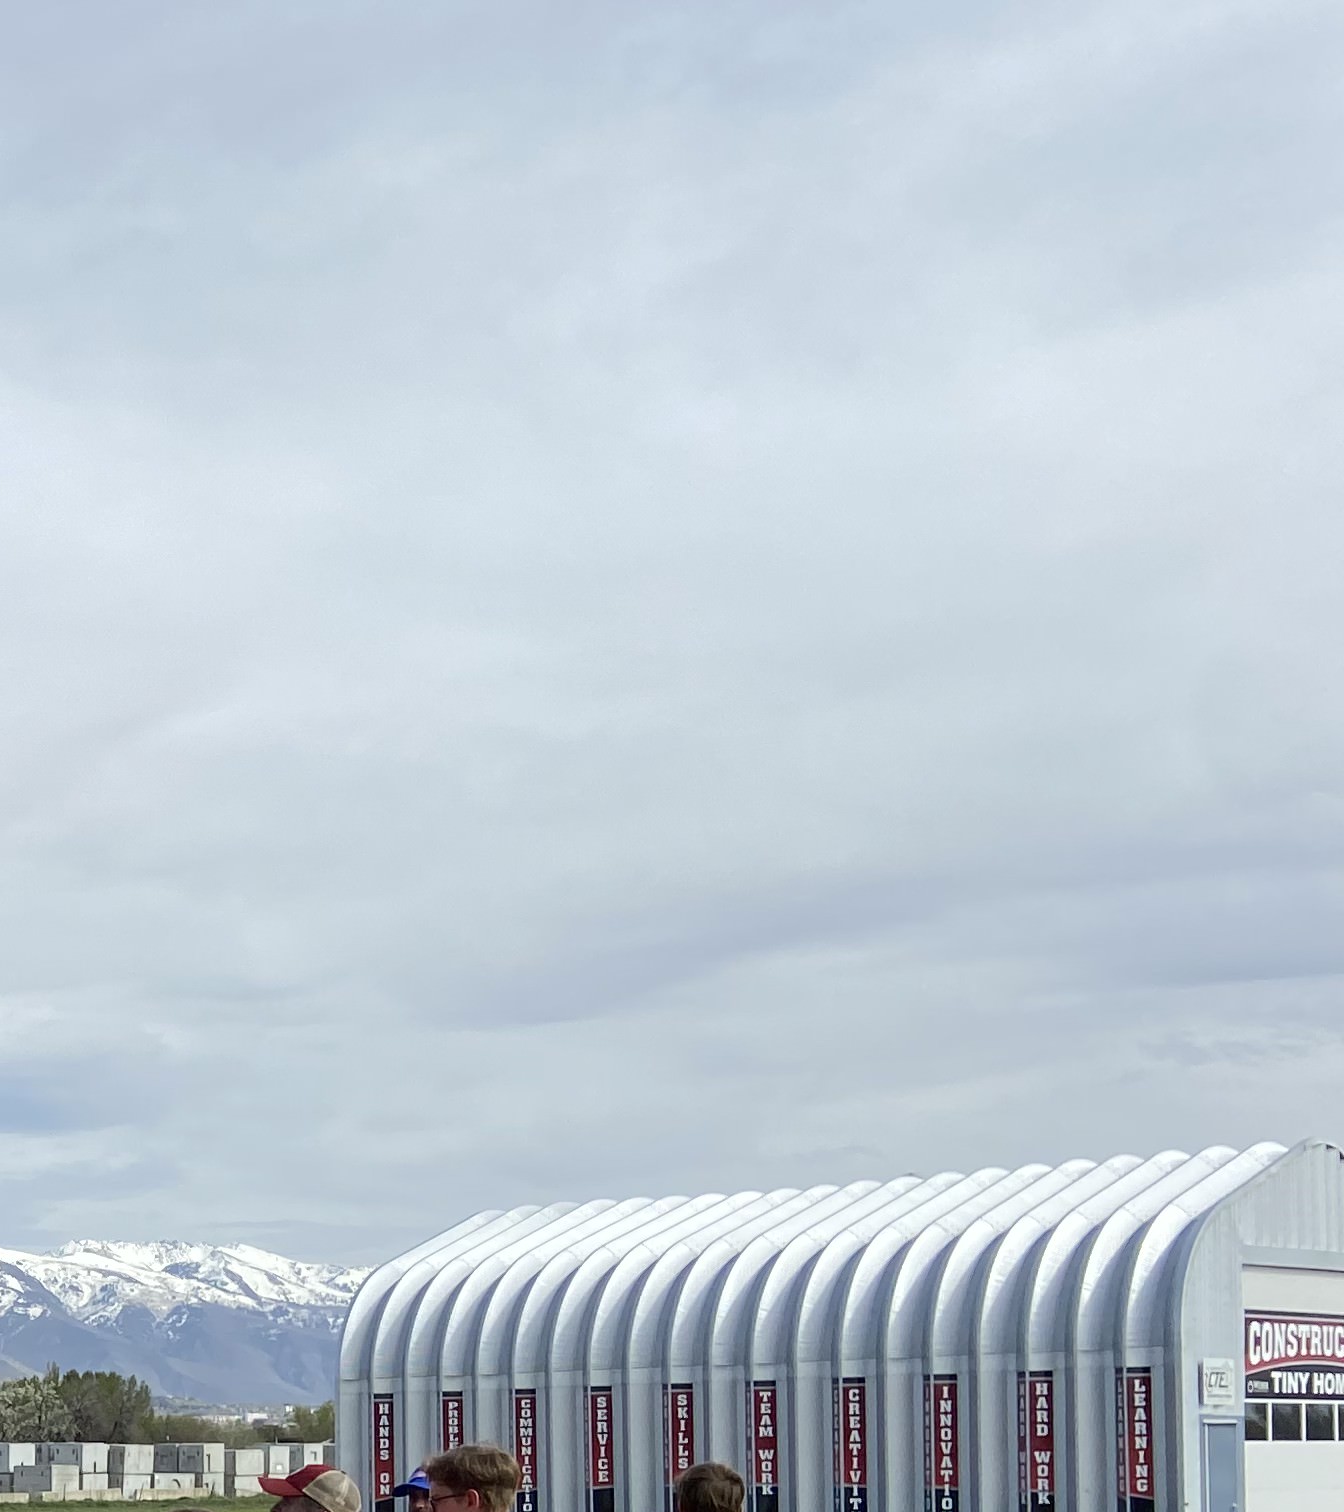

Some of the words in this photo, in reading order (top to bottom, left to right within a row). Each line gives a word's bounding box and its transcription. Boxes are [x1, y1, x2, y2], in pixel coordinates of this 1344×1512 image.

[1271, 1370, 1310, 1394] TINY
[378, 1402, 390, 1461] HANDS
[677, 1394, 689, 1469] SKILLS
[758, 1391, 773, 1438] TEAM
[1035, 1382, 1049, 1437] HARD
[1133, 1378, 1149, 1493] LEARNING
[596, 1396, 609, 1483] SERVICE
[380, 1472, 390, 1496] ON
[758, 1449, 774, 1496] WORK
[1033, 1451, 1051, 1505] WORK
